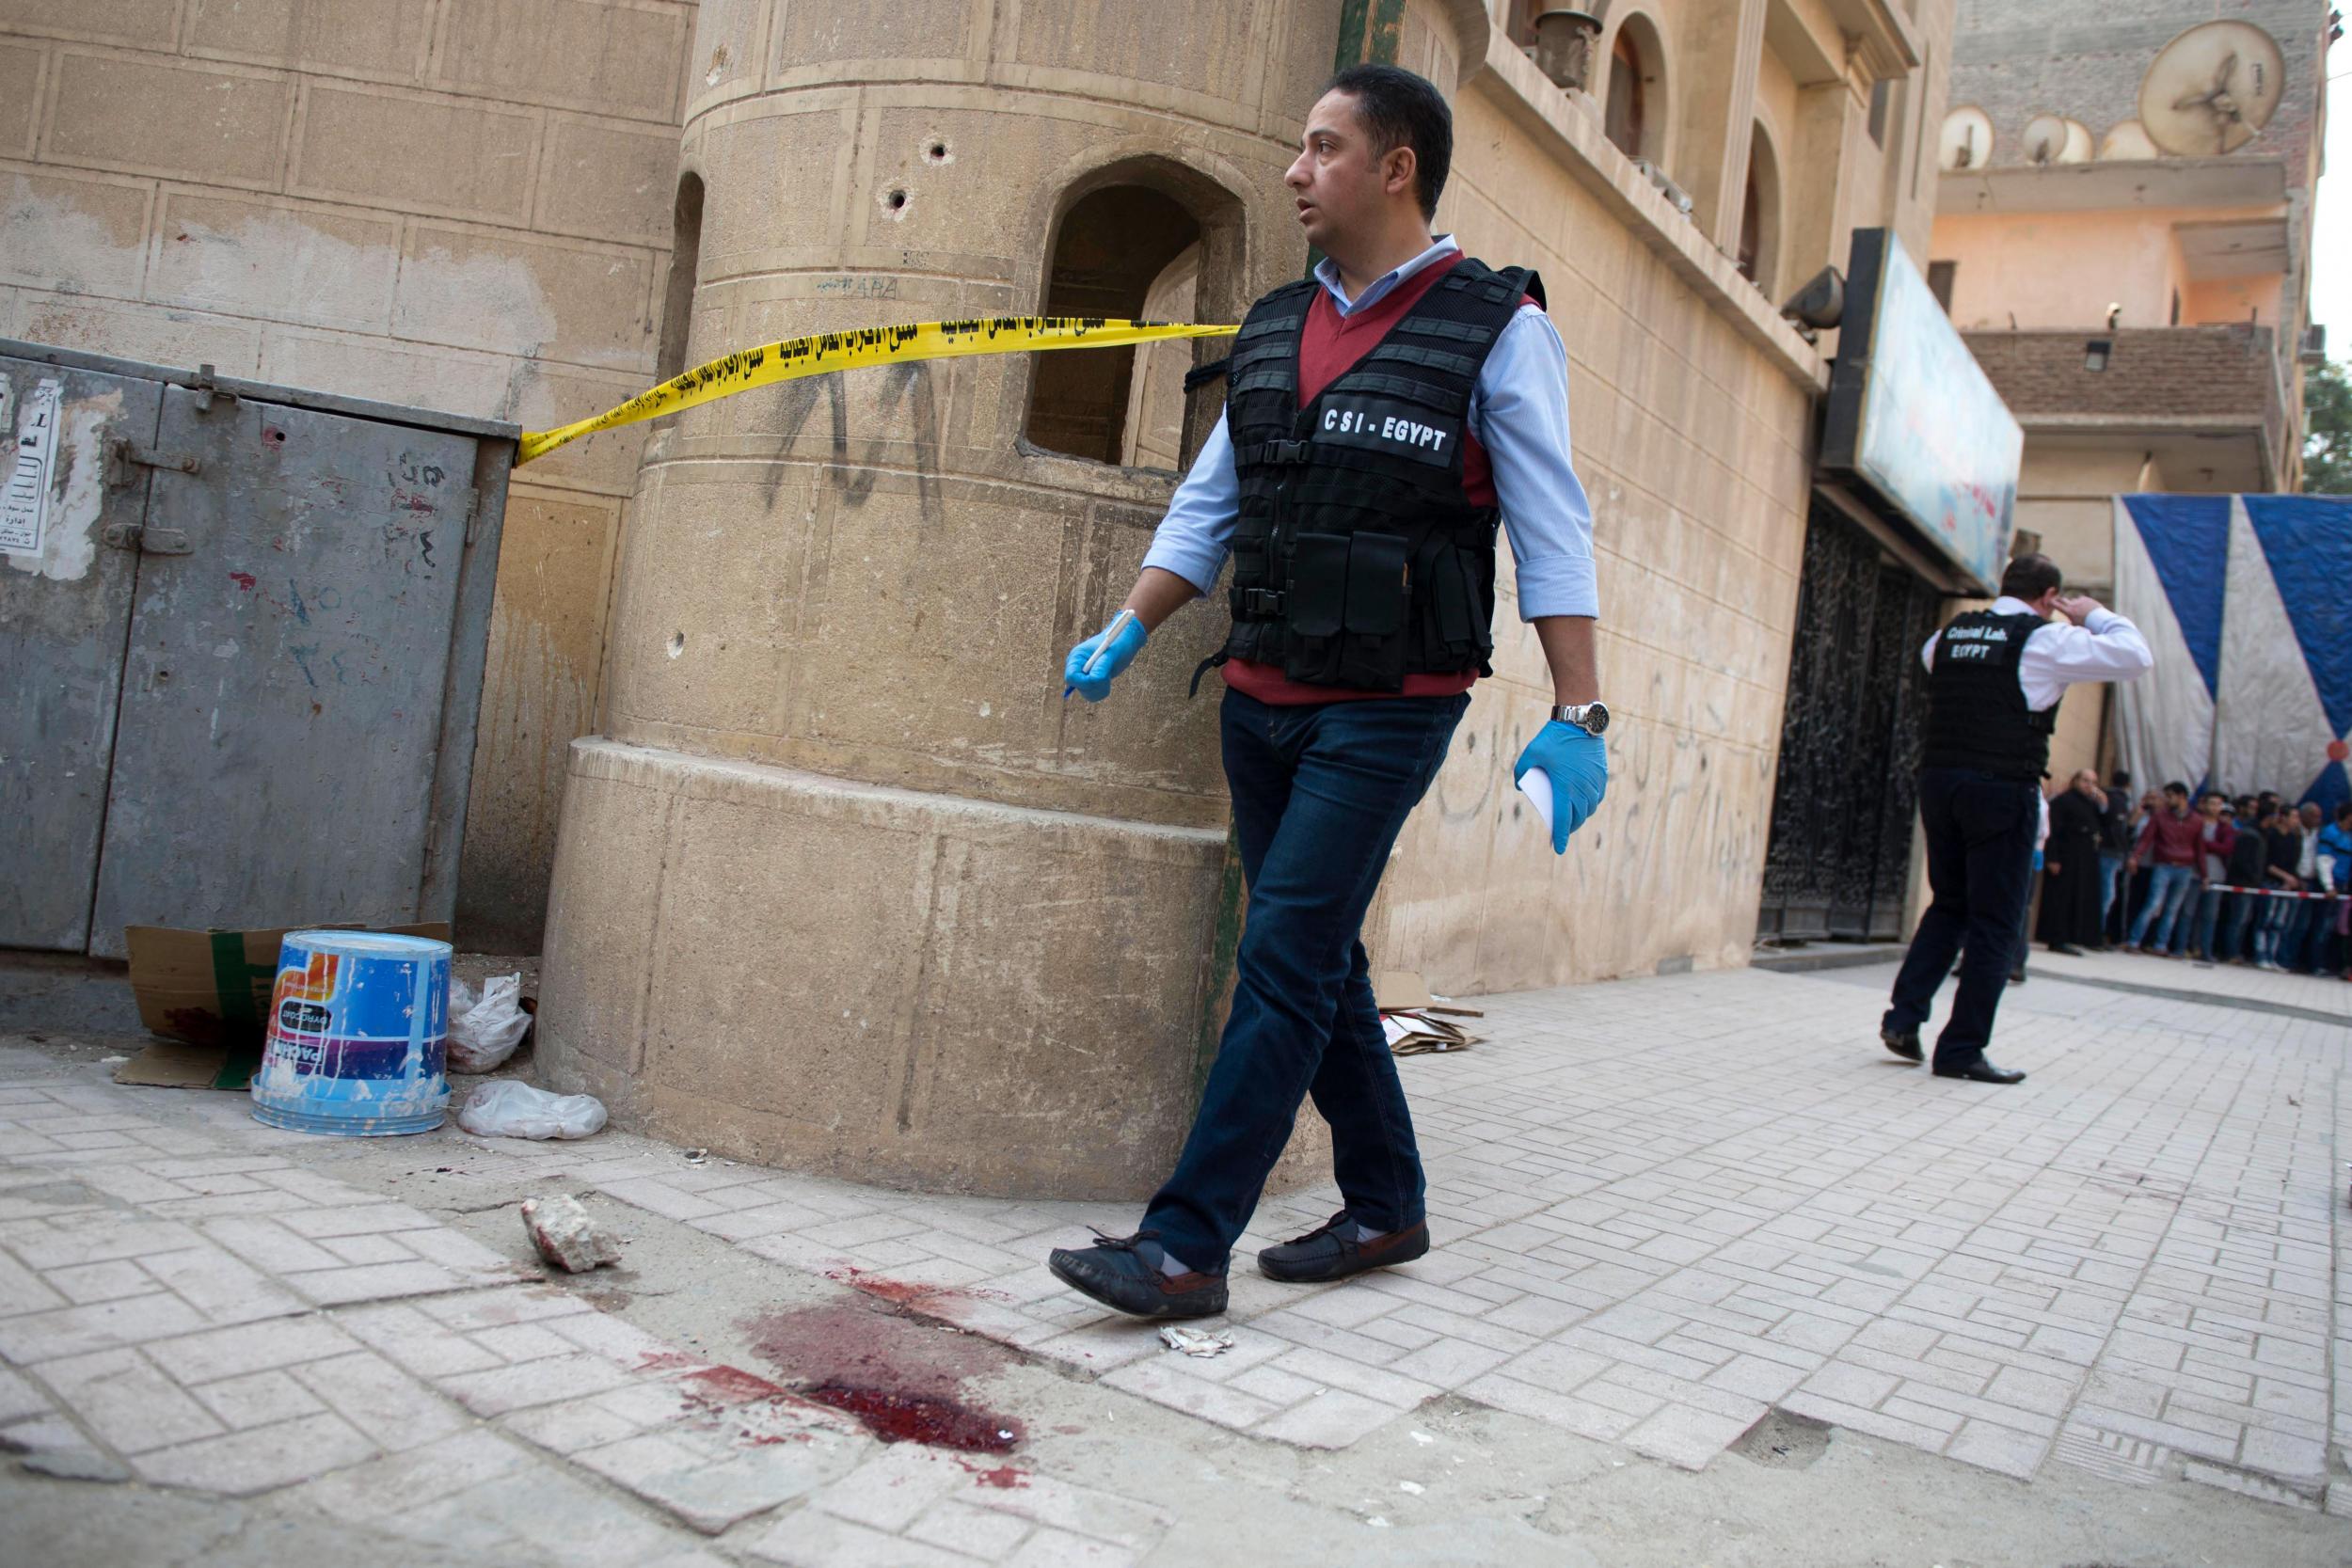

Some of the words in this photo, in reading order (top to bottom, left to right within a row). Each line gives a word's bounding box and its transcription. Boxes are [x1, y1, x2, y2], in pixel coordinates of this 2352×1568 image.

[1324, 408, 1364, 434] CSI
[1381, 416, 1446, 451] EGYPT
[1946, 626, 1985, 640] Criminal
[1950, 644, 1991, 658] EGYPT
